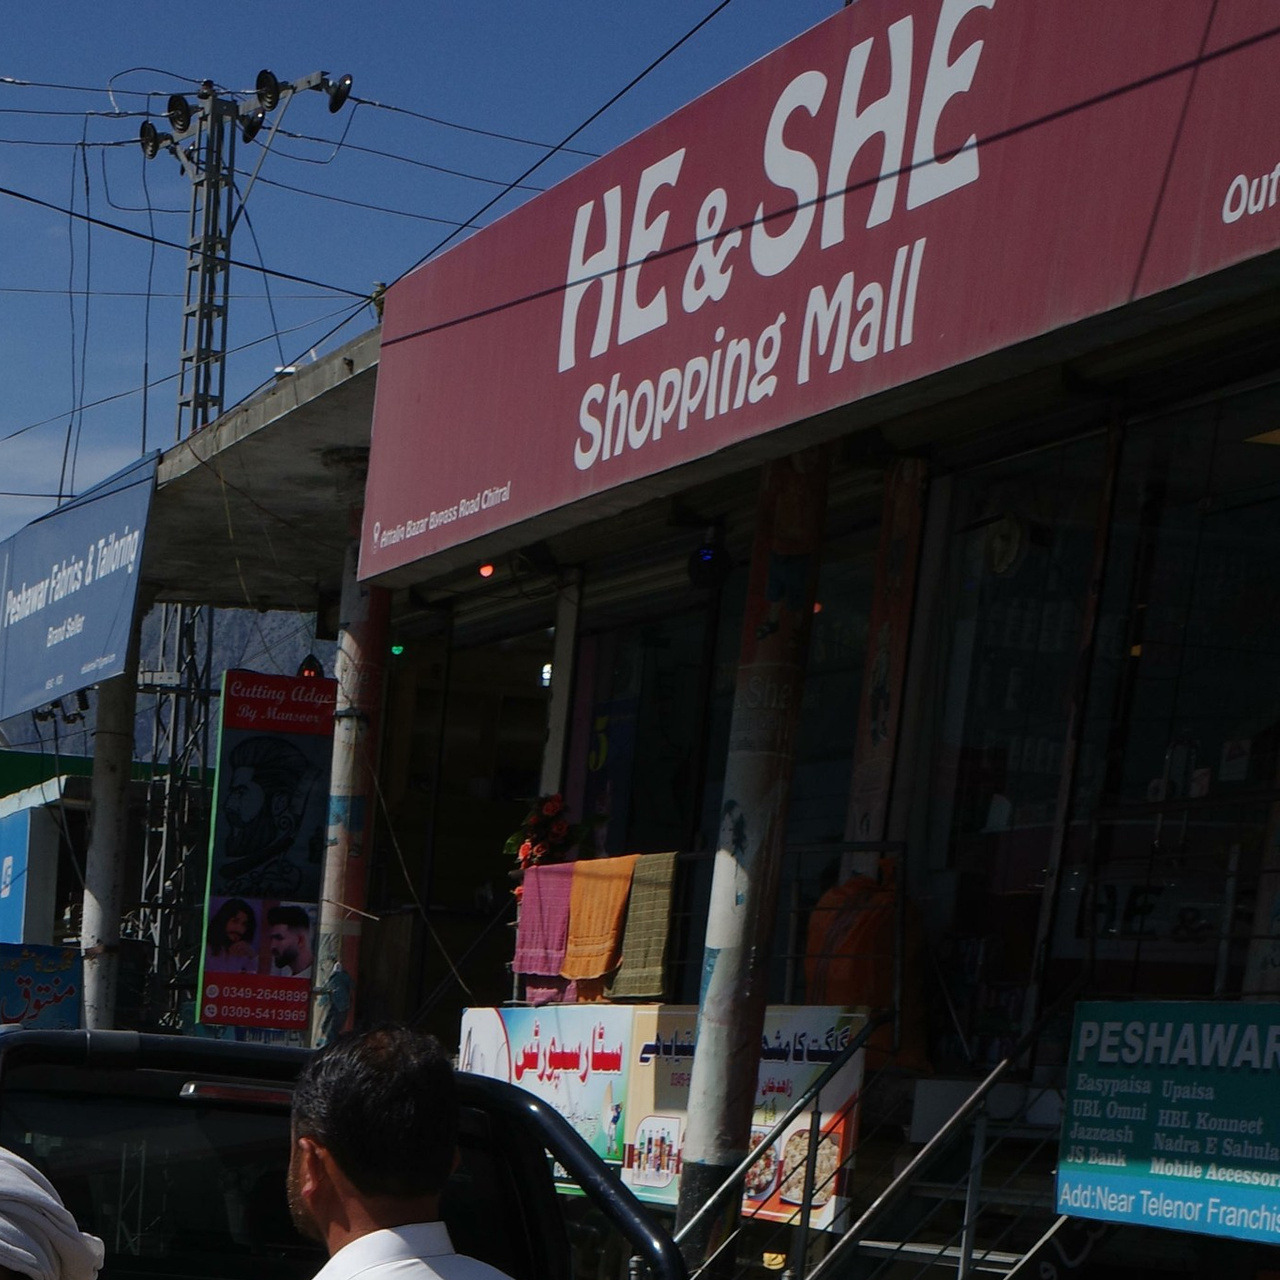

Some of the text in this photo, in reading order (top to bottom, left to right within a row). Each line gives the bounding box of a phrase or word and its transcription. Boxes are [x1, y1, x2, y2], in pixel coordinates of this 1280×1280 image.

[558, 0, 996, 374] HE & SHE
[574, 237, 927, 470] Shopping Mall
[406, 515, 428, 539] Bazar
[429, 506, 458, 530] Bypass
[459, 493, 481, 518] Road
[482, 481, 511, 509] Chitral
[85, 544, 95, 586] &
[230, 680, 287, 705] Cutting
[236, 704, 258, 723] By
[222, 985, 308, 1002] 0349-2648899
[221, 1004, 307, 1022] 0309-5413969
[1076, 1073, 1215, 1103] Easypaisa Upaisa
[1072, 1099, 1264, 1135] UBL Omni HBL Konnect
[1070, 1122, 1134, 1144] Jazzcash
[1153, 1133, 1200, 1154] Nadra
[1205, 1136, 1217, 1156] E
[1067, 1145, 1084, 1163] JS
[1087, 1149, 1128, 1167] Bank
[1150, 1156, 1203, 1179] Mobile
[1140, 1189, 1203, 1219] Telenor
